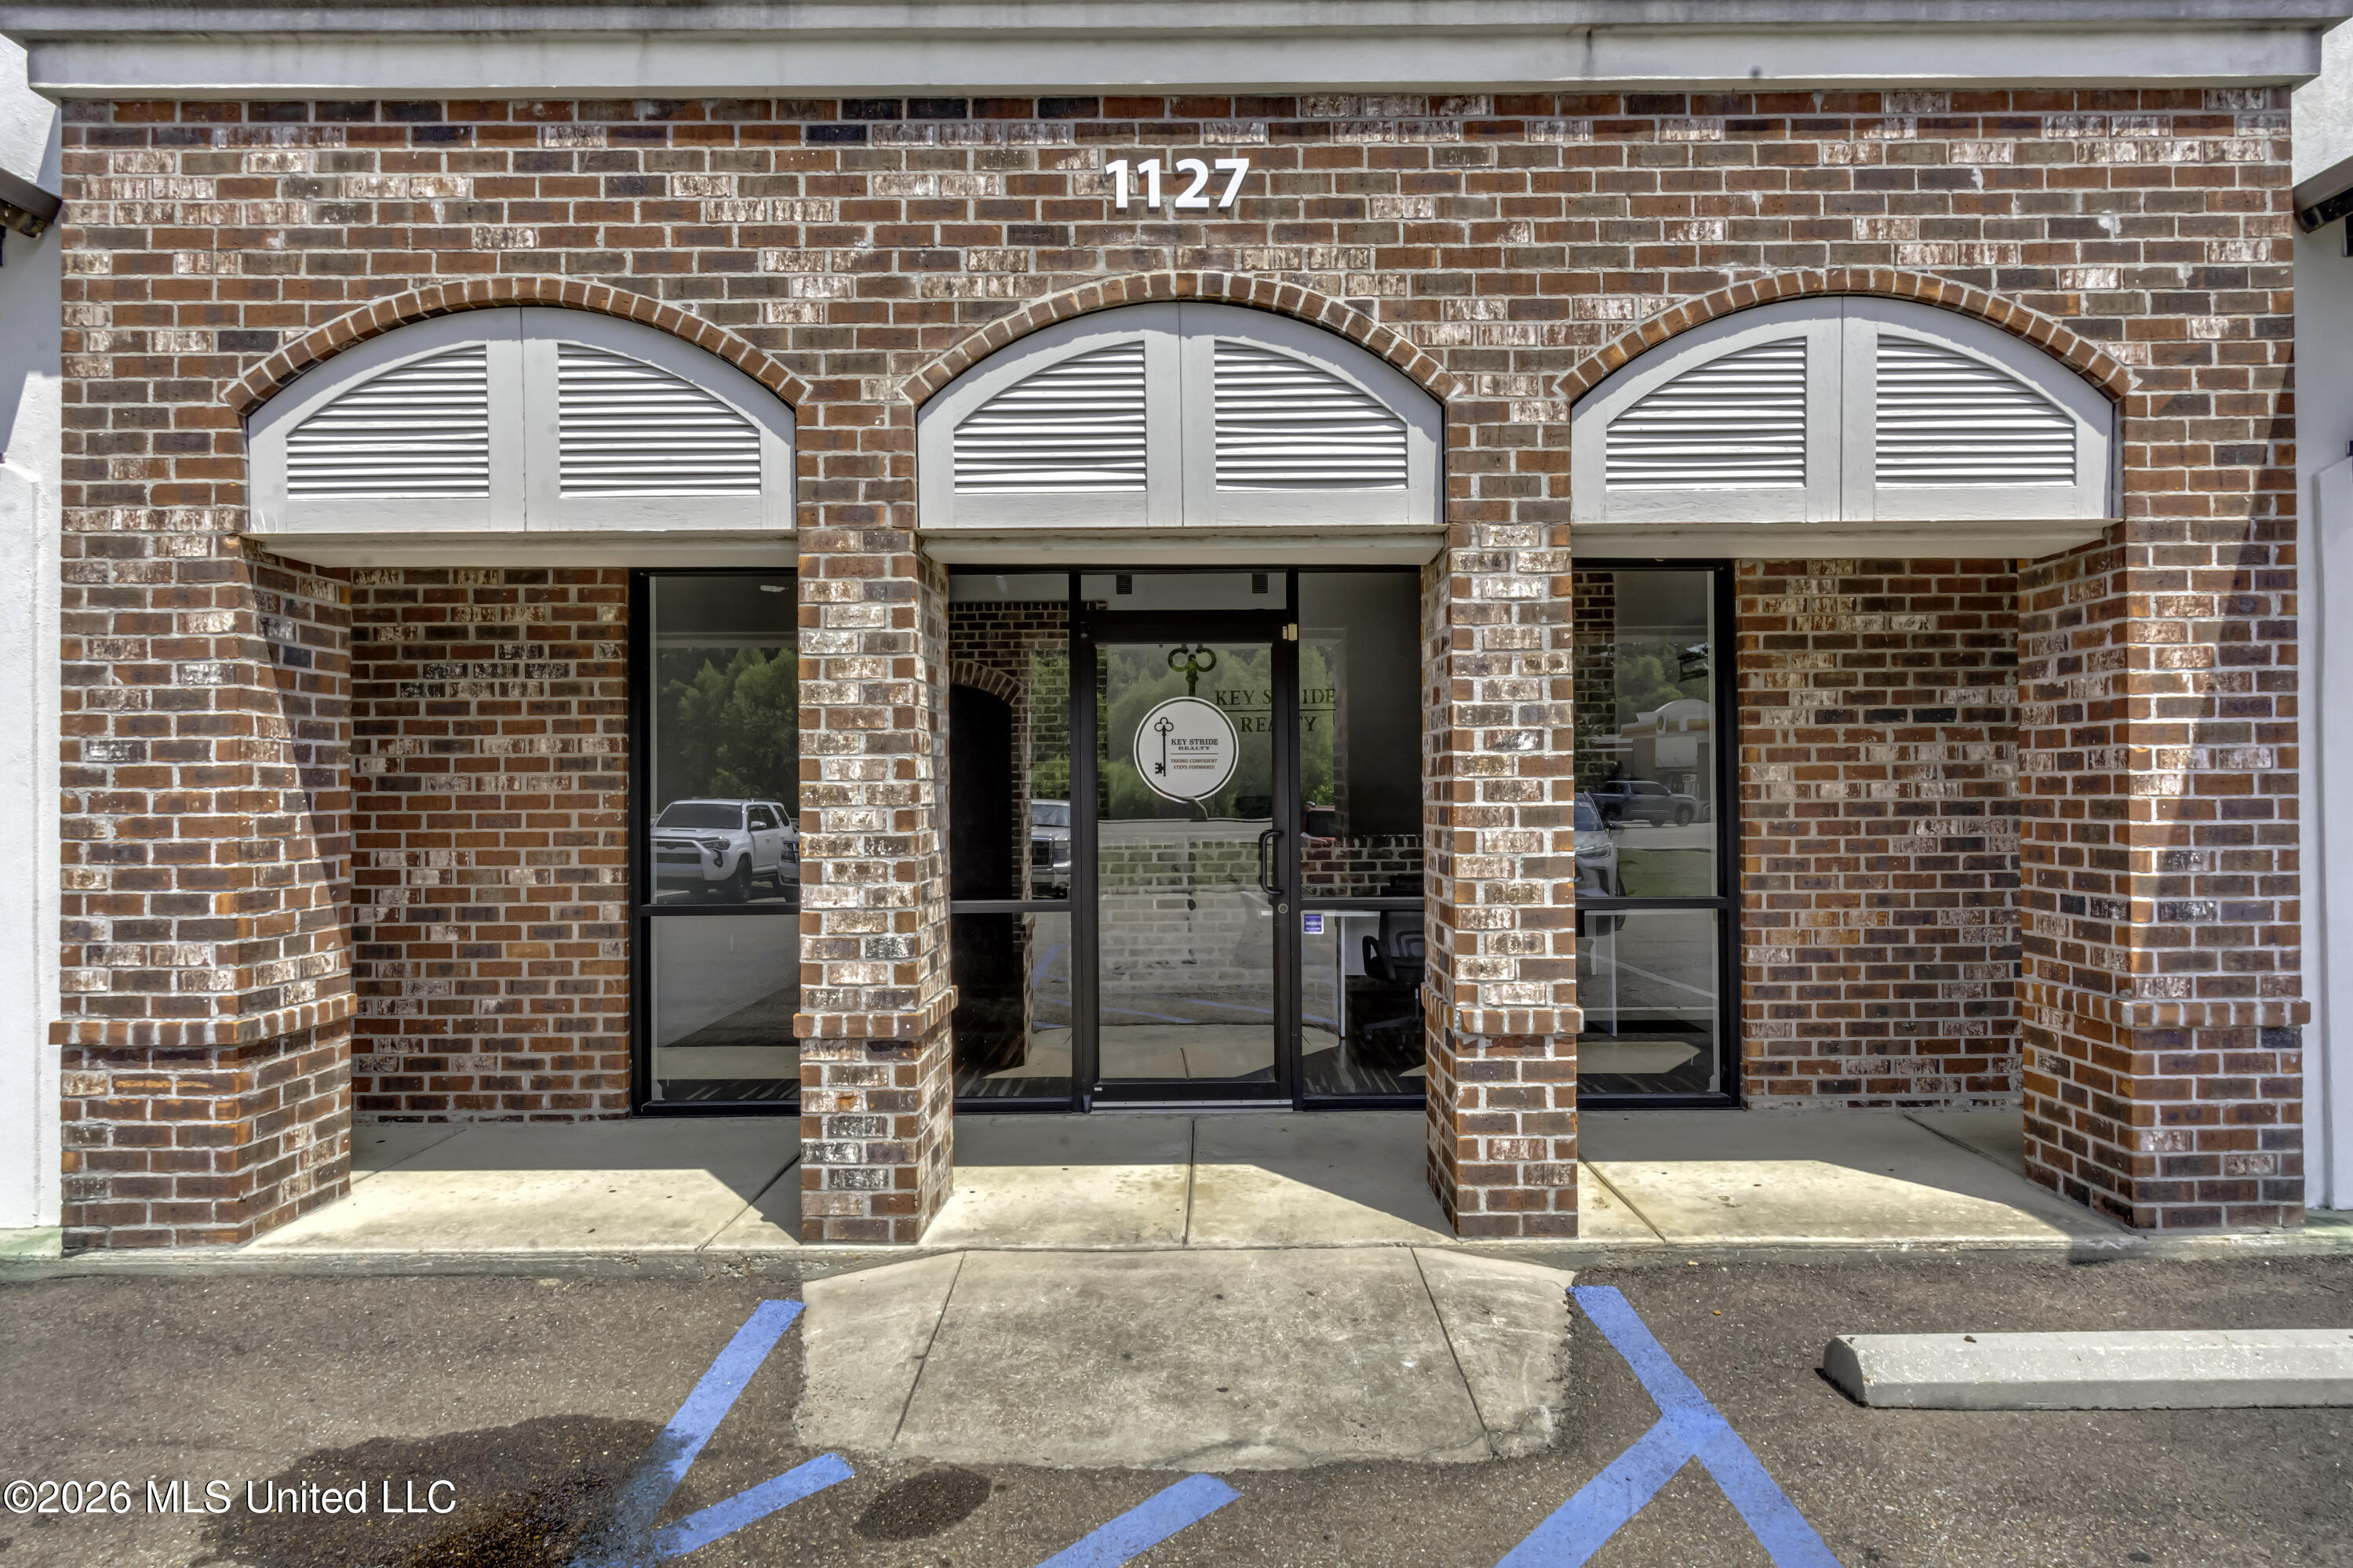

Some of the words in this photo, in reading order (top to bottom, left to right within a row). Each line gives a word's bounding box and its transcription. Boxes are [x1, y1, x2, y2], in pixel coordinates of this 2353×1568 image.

[1105, 158, 1250, 208] 1127
[1215, 689, 1255, 705] KEY
[1262, 688, 1336, 704] SIDE
[1240, 716, 1318, 733] REY
